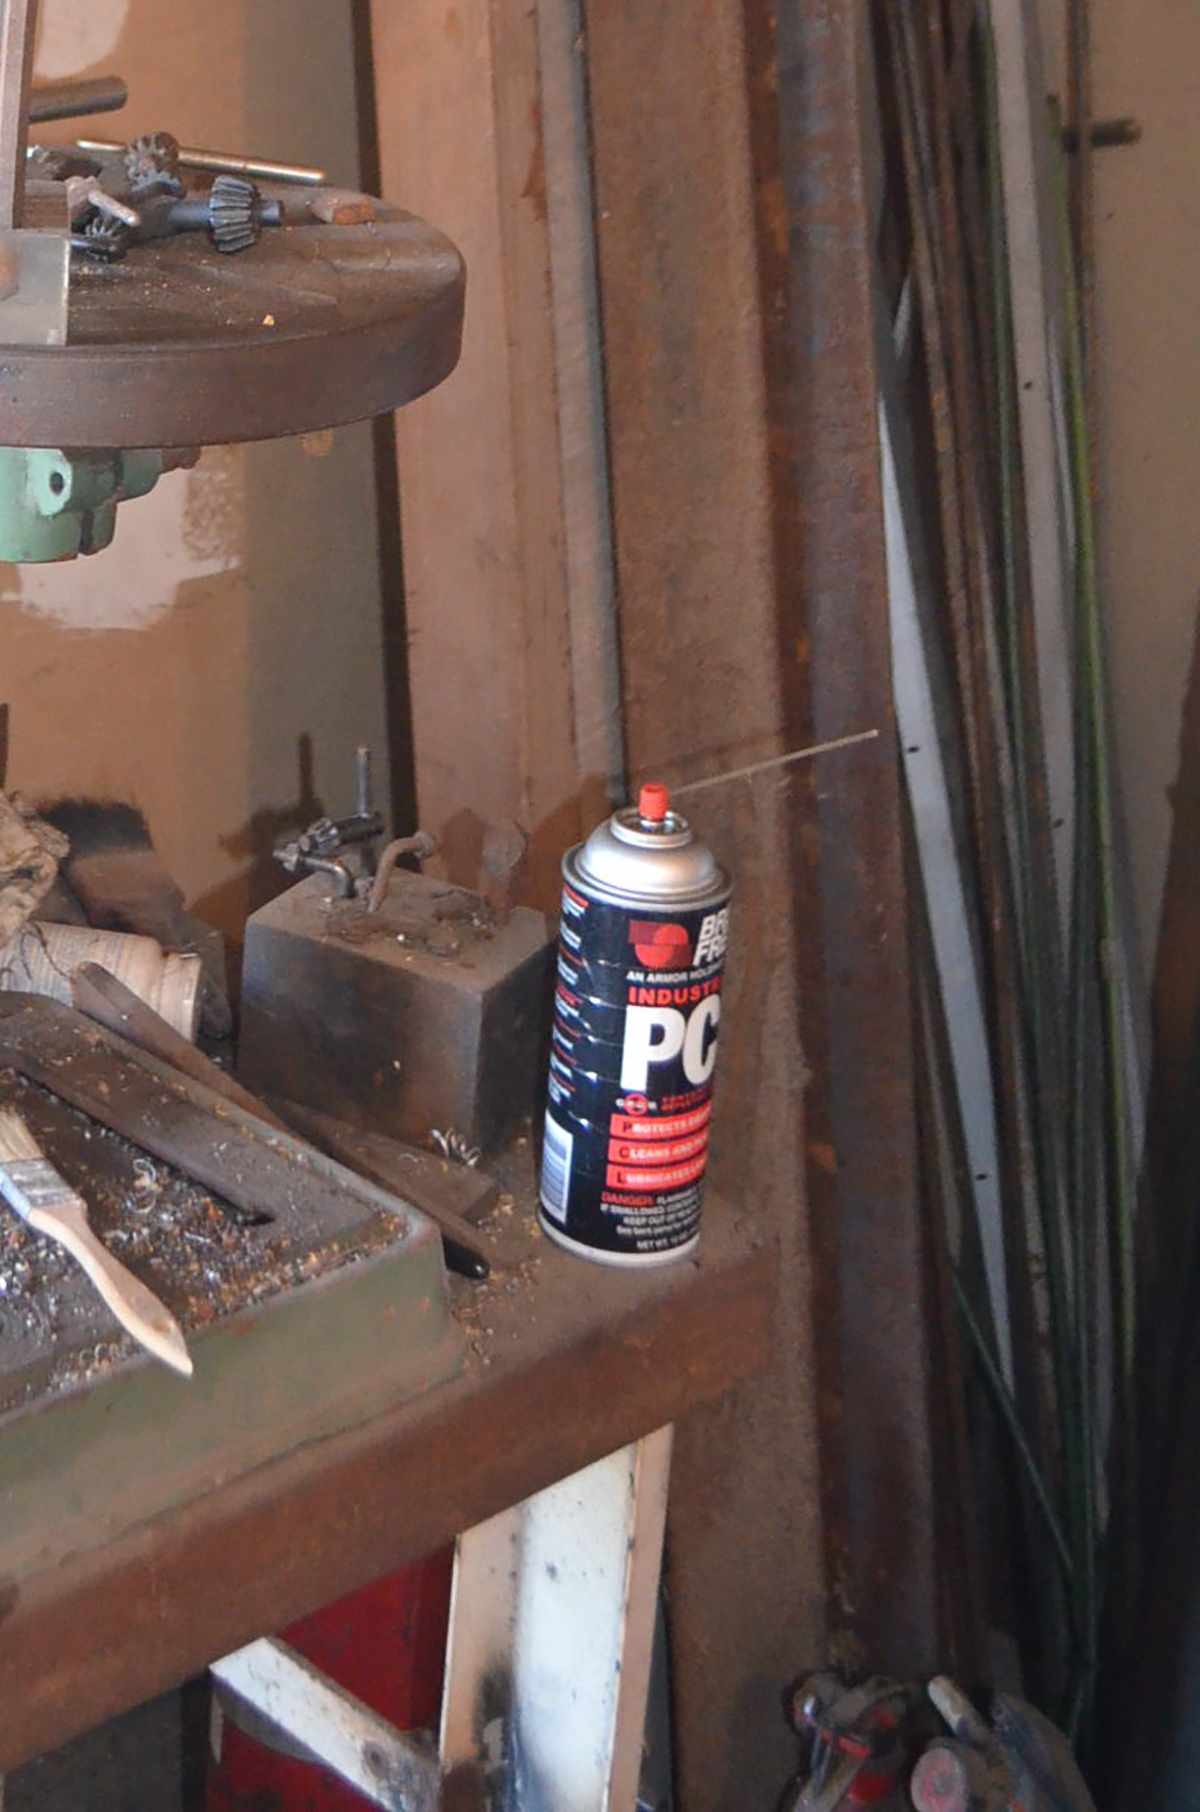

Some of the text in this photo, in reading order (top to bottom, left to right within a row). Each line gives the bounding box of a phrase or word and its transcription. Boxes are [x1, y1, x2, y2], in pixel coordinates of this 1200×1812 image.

[626, 971, 645, 983] AN
[646, 973, 689, 983] ARMOR
[621, 994, 721, 1092] PC
